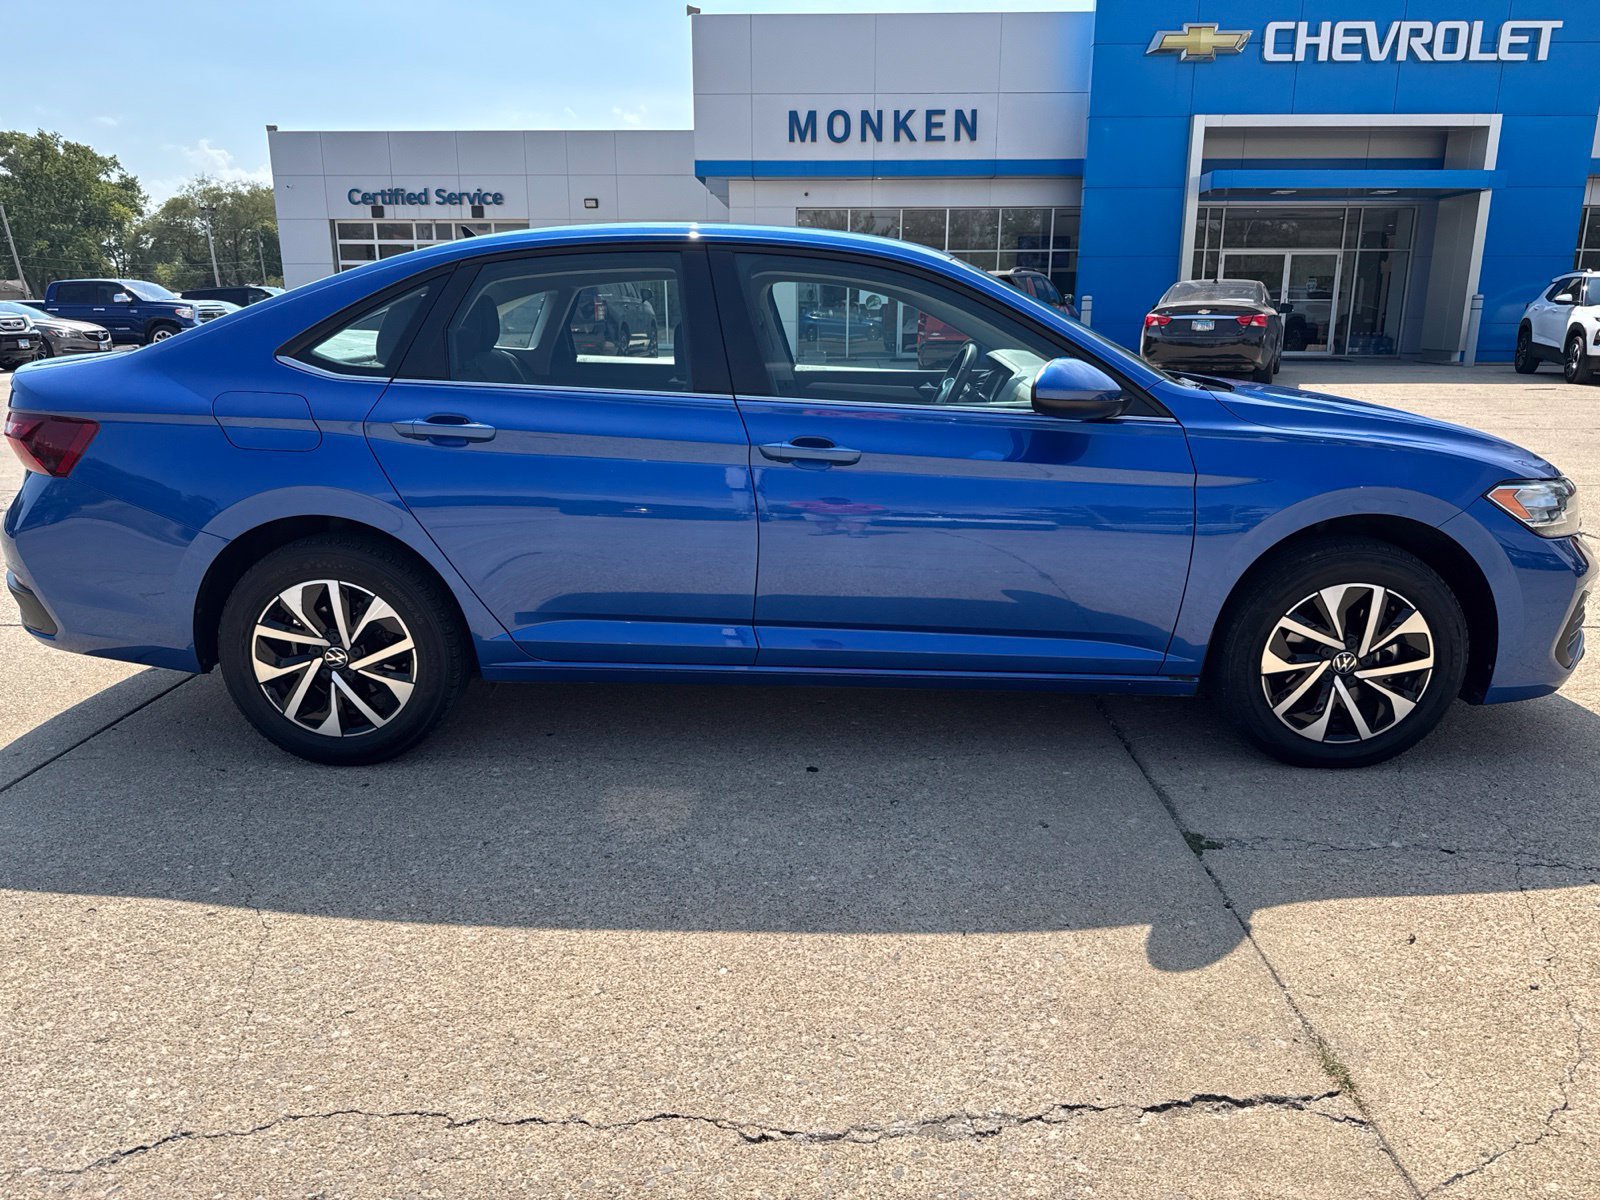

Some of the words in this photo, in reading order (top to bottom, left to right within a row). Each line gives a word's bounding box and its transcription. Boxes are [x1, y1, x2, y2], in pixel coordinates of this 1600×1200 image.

[1263, 20, 1564, 62] CHEVROLET
[788, 109, 978, 143] MONKEN
[347, 188, 430, 205] Certified
[435, 189, 504, 205] Service
